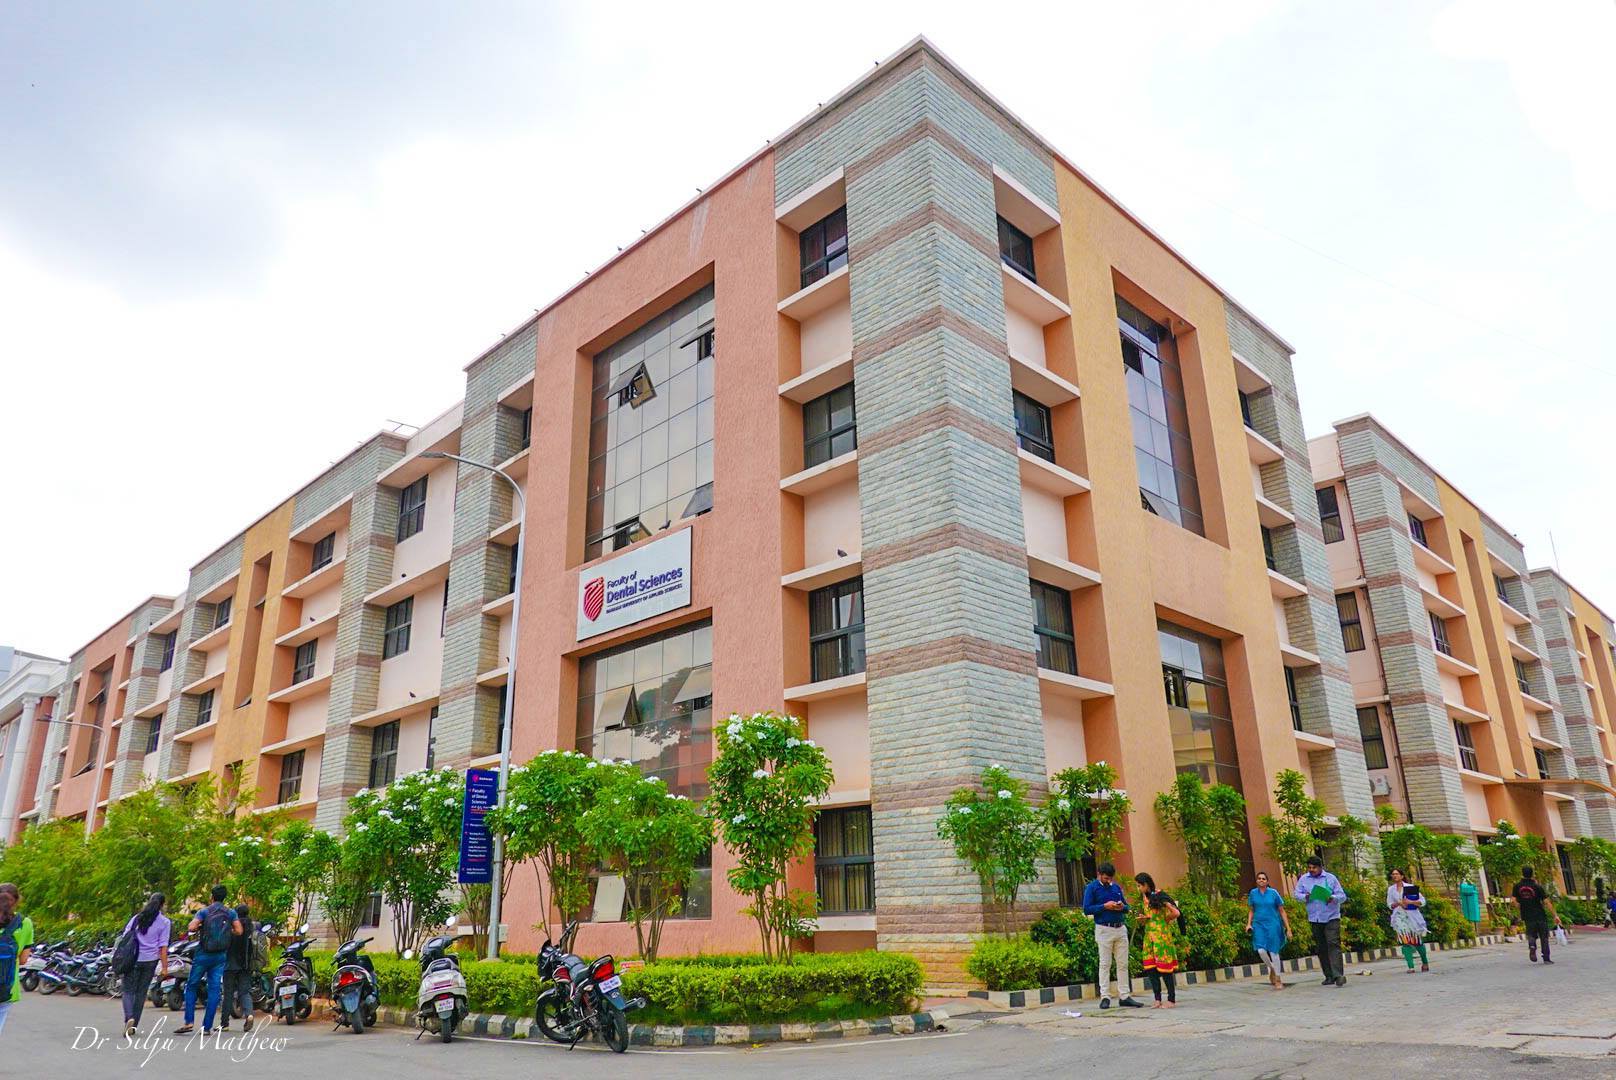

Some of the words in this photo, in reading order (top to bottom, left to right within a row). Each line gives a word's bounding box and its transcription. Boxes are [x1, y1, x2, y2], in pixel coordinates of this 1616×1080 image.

[606, 582, 637, 604] Dental
[639, 568, 683, 591] Sciences
[607, 575, 629, 589] Faculty
[630, 571, 637, 581] of
